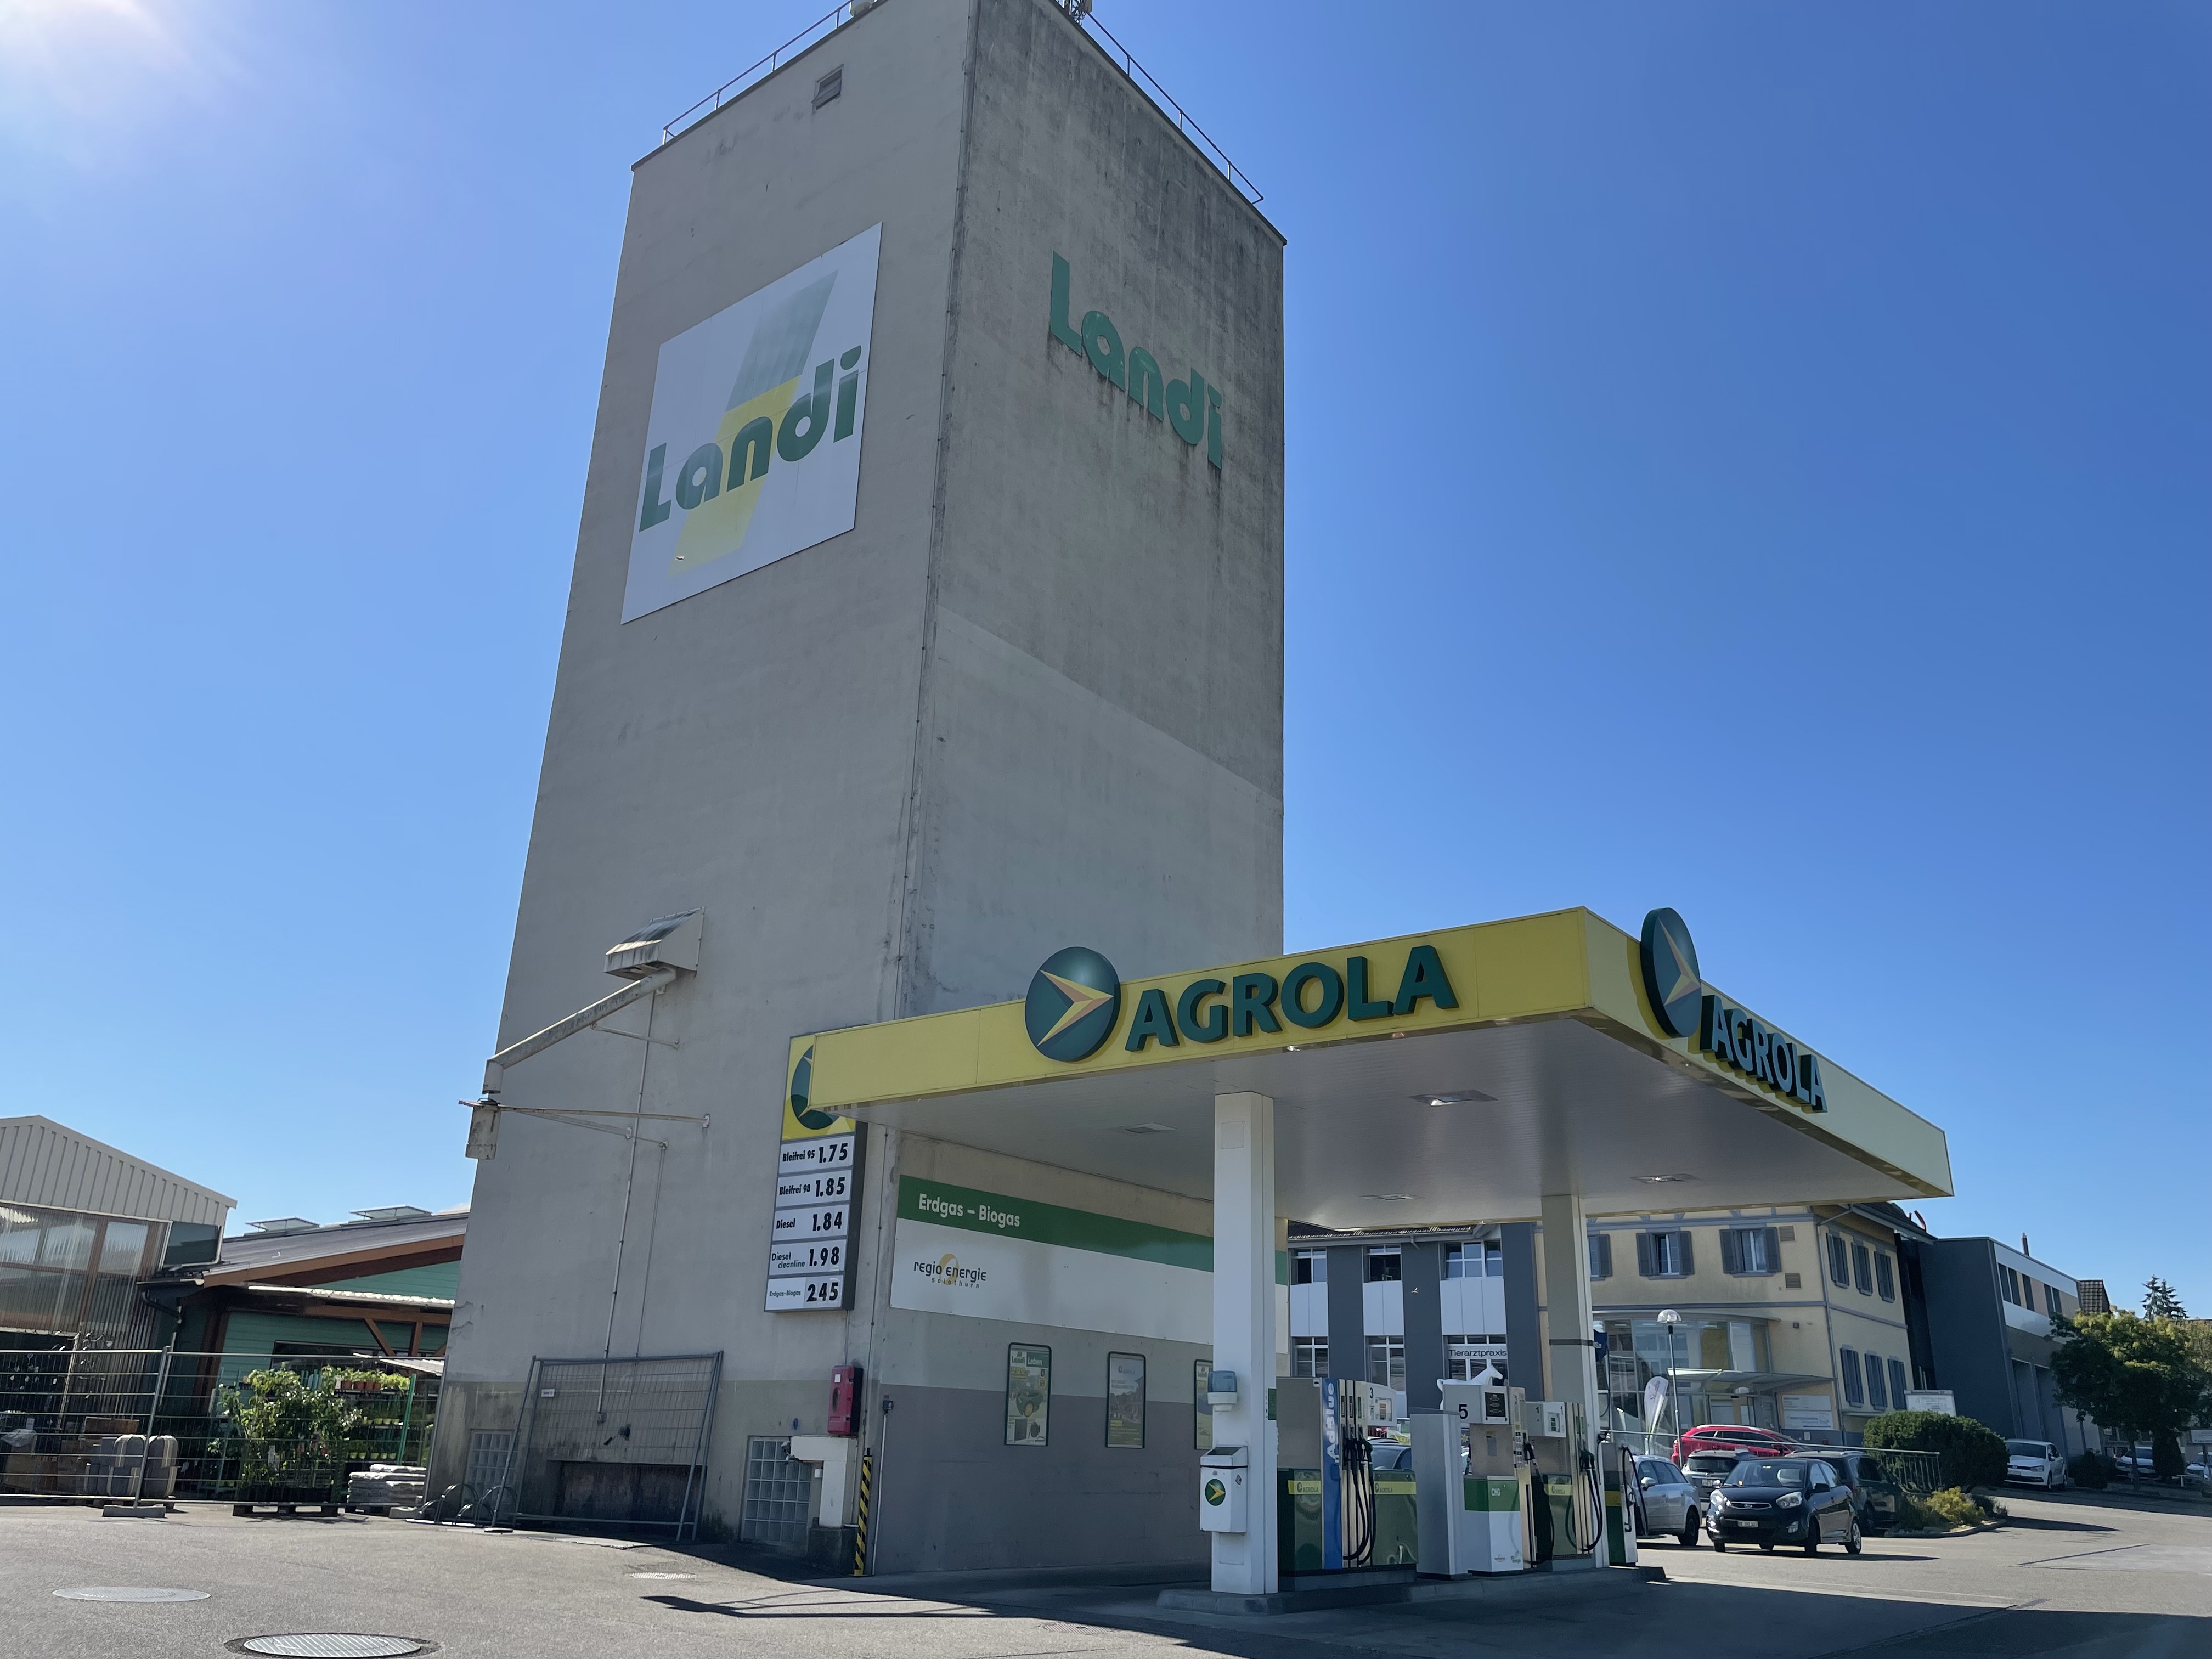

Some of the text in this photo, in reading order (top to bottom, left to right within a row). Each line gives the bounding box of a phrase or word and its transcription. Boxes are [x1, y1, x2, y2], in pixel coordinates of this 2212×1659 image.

[1050, 250, 1222, 470] Landi
[639, 345, 862, 533] Landi
[1125, 944, 1460, 1052] AGROLA
[1700, 994, 1828, 1113] AGROLA
[782, 1143, 848, 1164] Bleifrei 95 1.75
[779, 1177, 845, 1197] Bleifrei 98 1.85
[776, 1211, 842, 1231] Diesel 1.84
[919, 1193, 963, 1218] Erdgas
[979, 1204, 1020, 1228] Biogas
[771, 1246, 840, 1267] Diesel 1.98
[778, 1260, 805, 1268] cleanline
[913, 1261, 986, 1283] regio energie
[932, 1277, 979, 1289] solothurn
[1028, 1357, 1042, 1365] Leben
[1448, 1348, 1508, 1357] Tierarztpraxis
[1369, 1387, 1374, 1398] 3
[1327, 1381, 1337, 1461] AdBlue
[1458, 1404, 1468, 1419] 5
